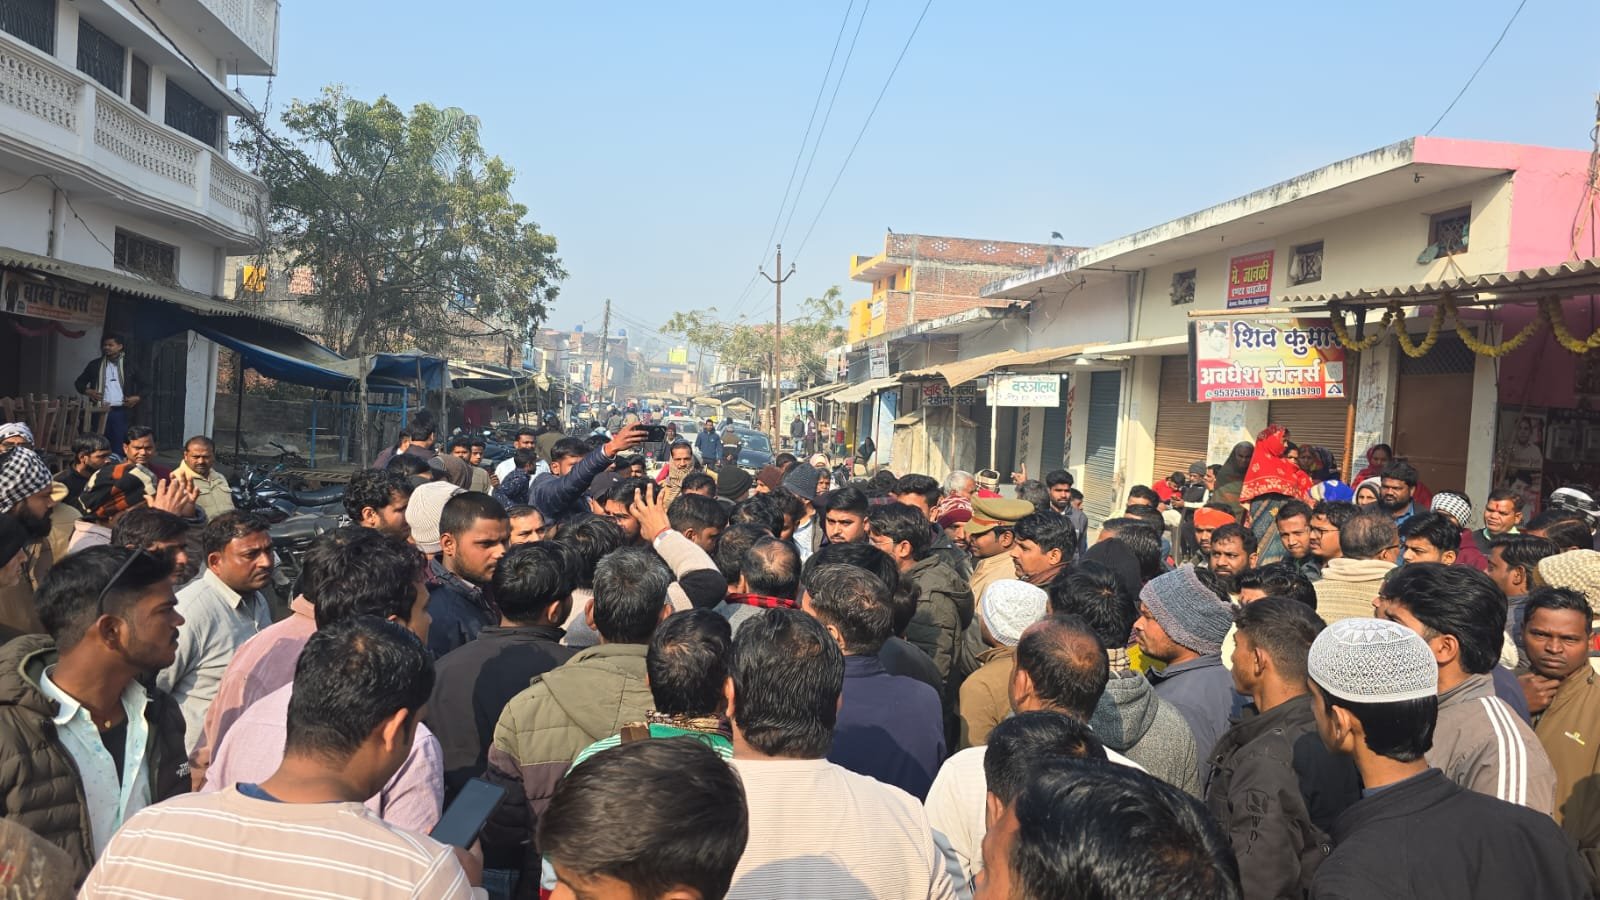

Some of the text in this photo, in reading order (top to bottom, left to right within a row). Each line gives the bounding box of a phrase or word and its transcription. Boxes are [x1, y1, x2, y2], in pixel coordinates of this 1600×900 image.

[1243, 261, 1269, 282] जानकी
[1234, 321, 1277, 348] शिव
[1200, 358, 1321, 384] अवधेश ज्वेलर्स
[1011, 381, 1057, 393] वस्त्रालय
